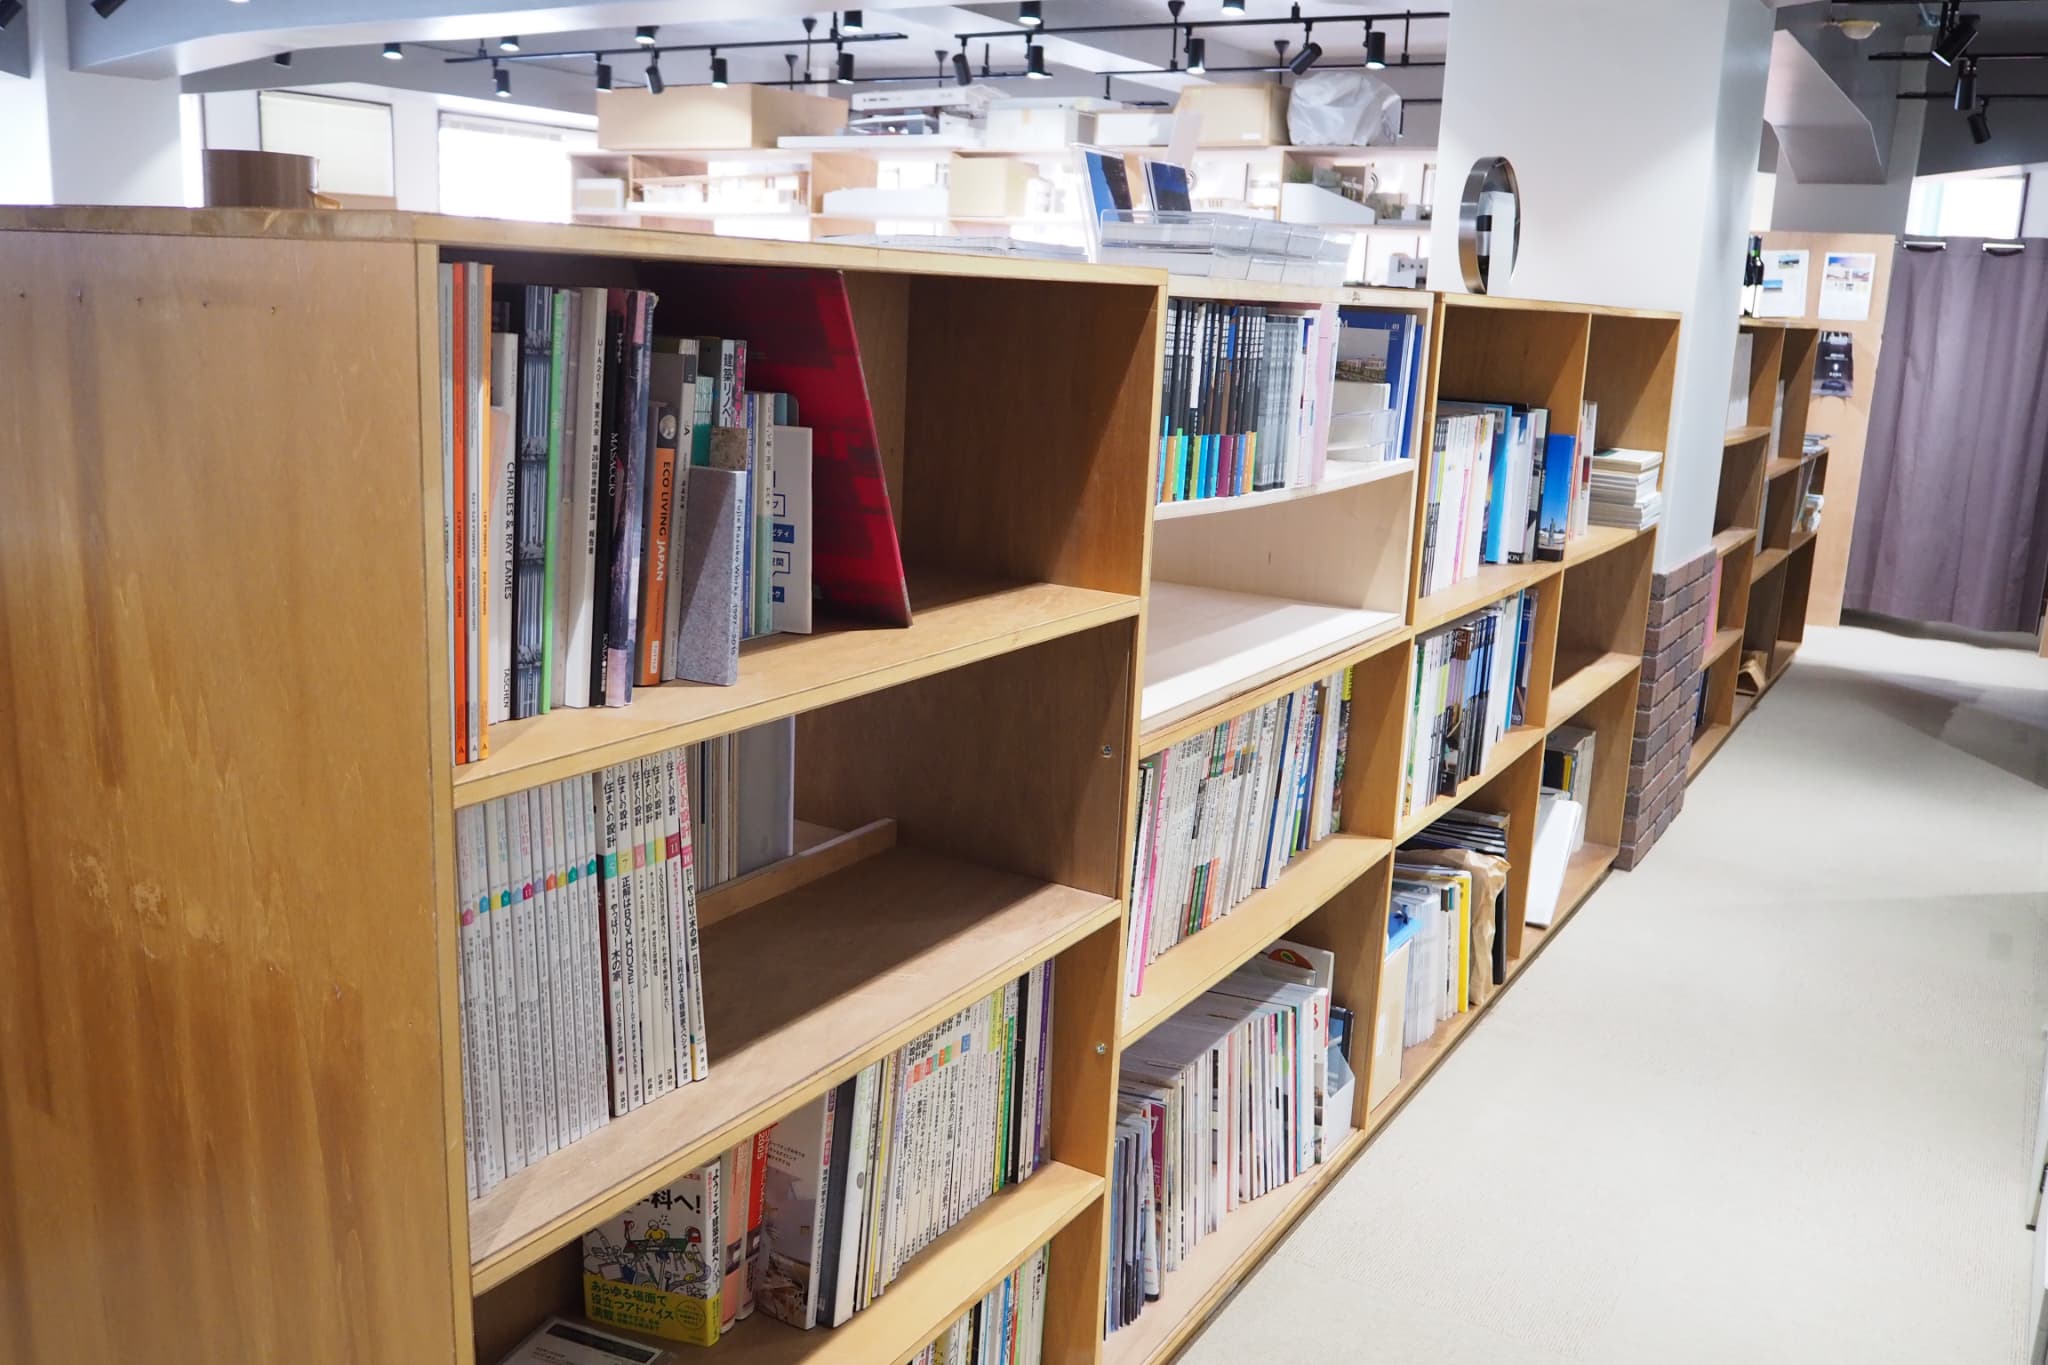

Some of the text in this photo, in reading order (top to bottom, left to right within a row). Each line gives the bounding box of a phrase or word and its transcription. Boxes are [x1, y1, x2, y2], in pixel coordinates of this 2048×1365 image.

[608, 432, 618, 497] MASACCIO
[661, 461, 672, 489] ECO
[504, 462, 516, 601] CHARLES & RAY EAMES
[659, 491, 669, 537] LIVING
[655, 539, 667, 582] JAPAN
[503, 668, 511, 708] TASCHEN
[625, 938, 635, 984] HOUSE
[637, 1189, 701, 1215] 科へ!
